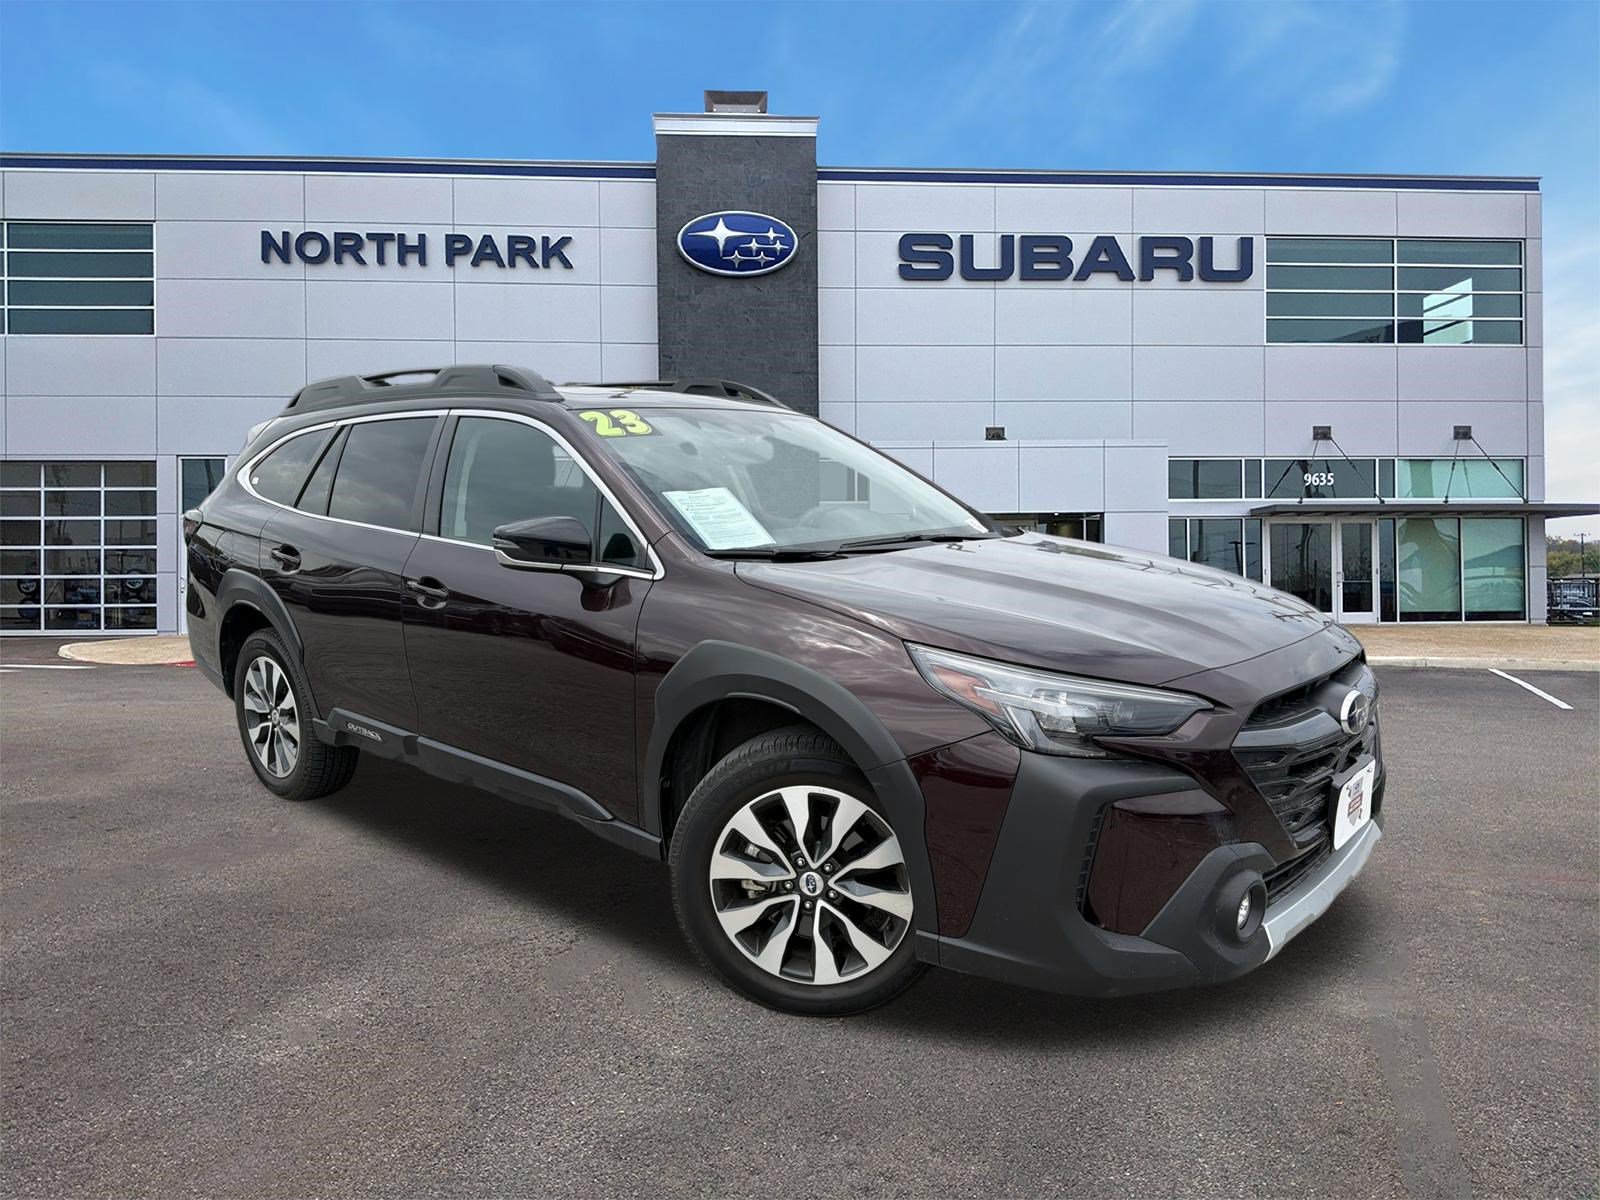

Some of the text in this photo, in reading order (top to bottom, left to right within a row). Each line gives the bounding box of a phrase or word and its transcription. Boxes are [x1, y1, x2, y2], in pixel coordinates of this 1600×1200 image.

[261, 230, 574, 270] NORTH PARK
[898, 232, 1254, 283] SUBARU
[578, 409, 652, 437] 23
[1303, 472, 1335, 486] 9635
